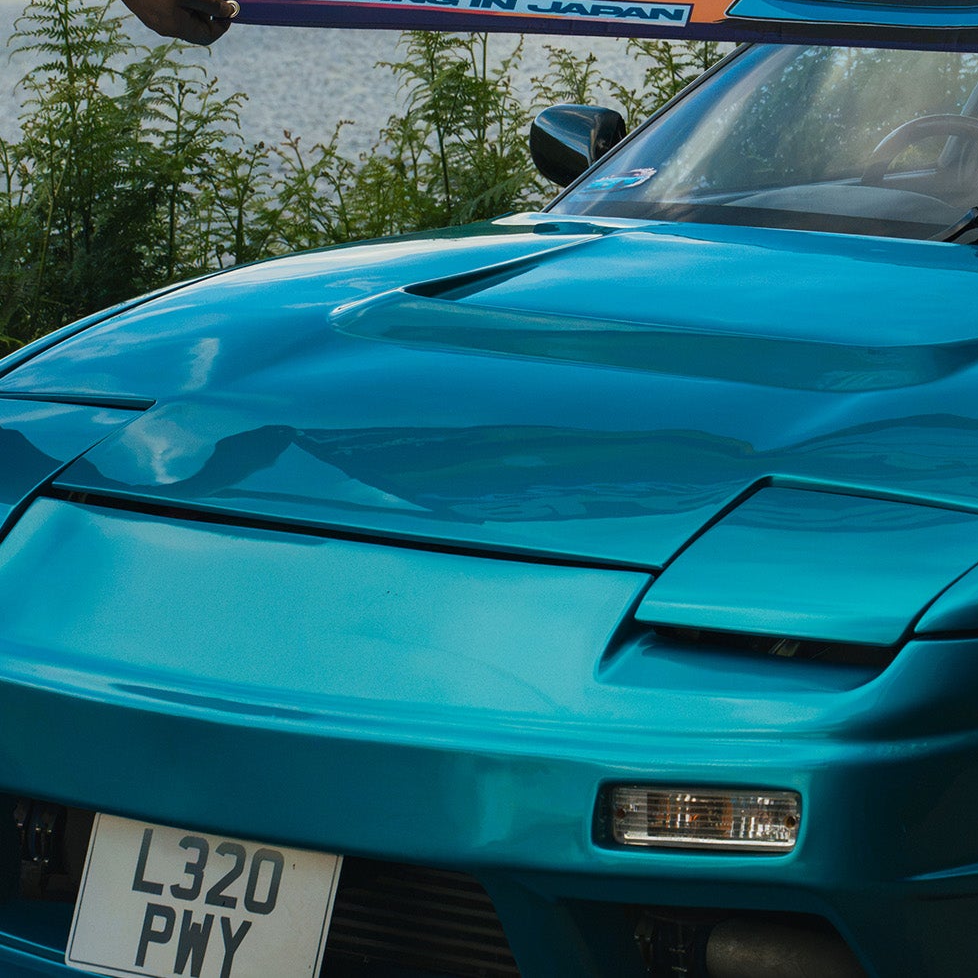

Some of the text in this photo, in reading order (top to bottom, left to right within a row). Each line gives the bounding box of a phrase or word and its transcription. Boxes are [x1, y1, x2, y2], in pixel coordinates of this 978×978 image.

[527, 1, 687, 21] JAPAN
[131, 828, 285, 915] L320
[135, 902, 252, 978] PWY
